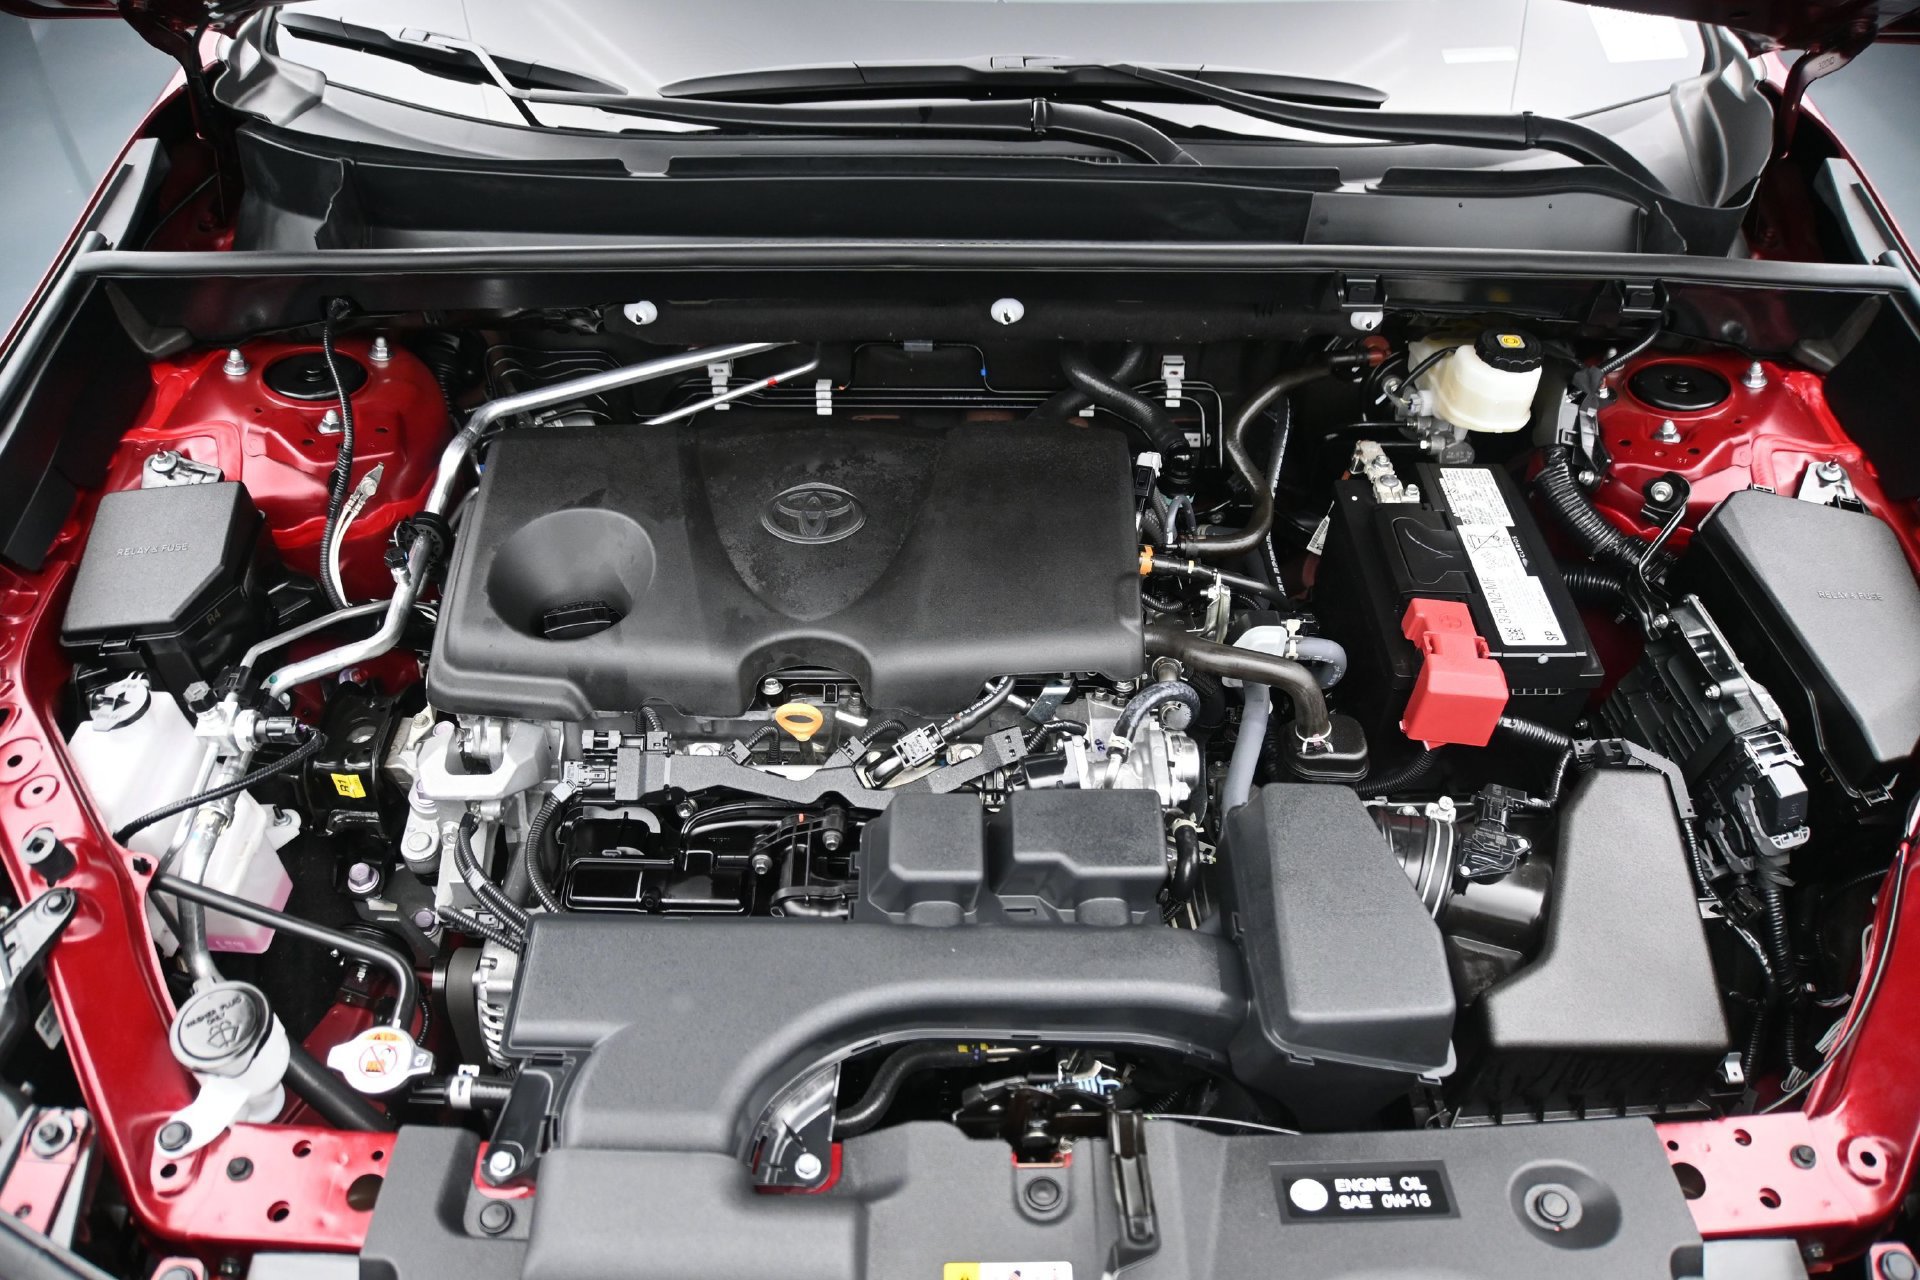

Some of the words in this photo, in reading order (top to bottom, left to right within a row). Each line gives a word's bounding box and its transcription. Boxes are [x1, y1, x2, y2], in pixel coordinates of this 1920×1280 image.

[117, 546, 151, 557] RELAY
[161, 543, 188, 553] FUSE
[1817, 591, 1847, 600] RELAY
[1858, 592, 1883, 601] FUSE
[207, 609, 221, 625] R4
[1544, 630, 1560, 641] SP
[1334, 1177, 1393, 1193] ENGINE
[1399, 1176, 1427, 1191] OIL
[1339, 1194, 1373, 1210] SAE
[1381, 1193, 1432, 1208] 0W-16
